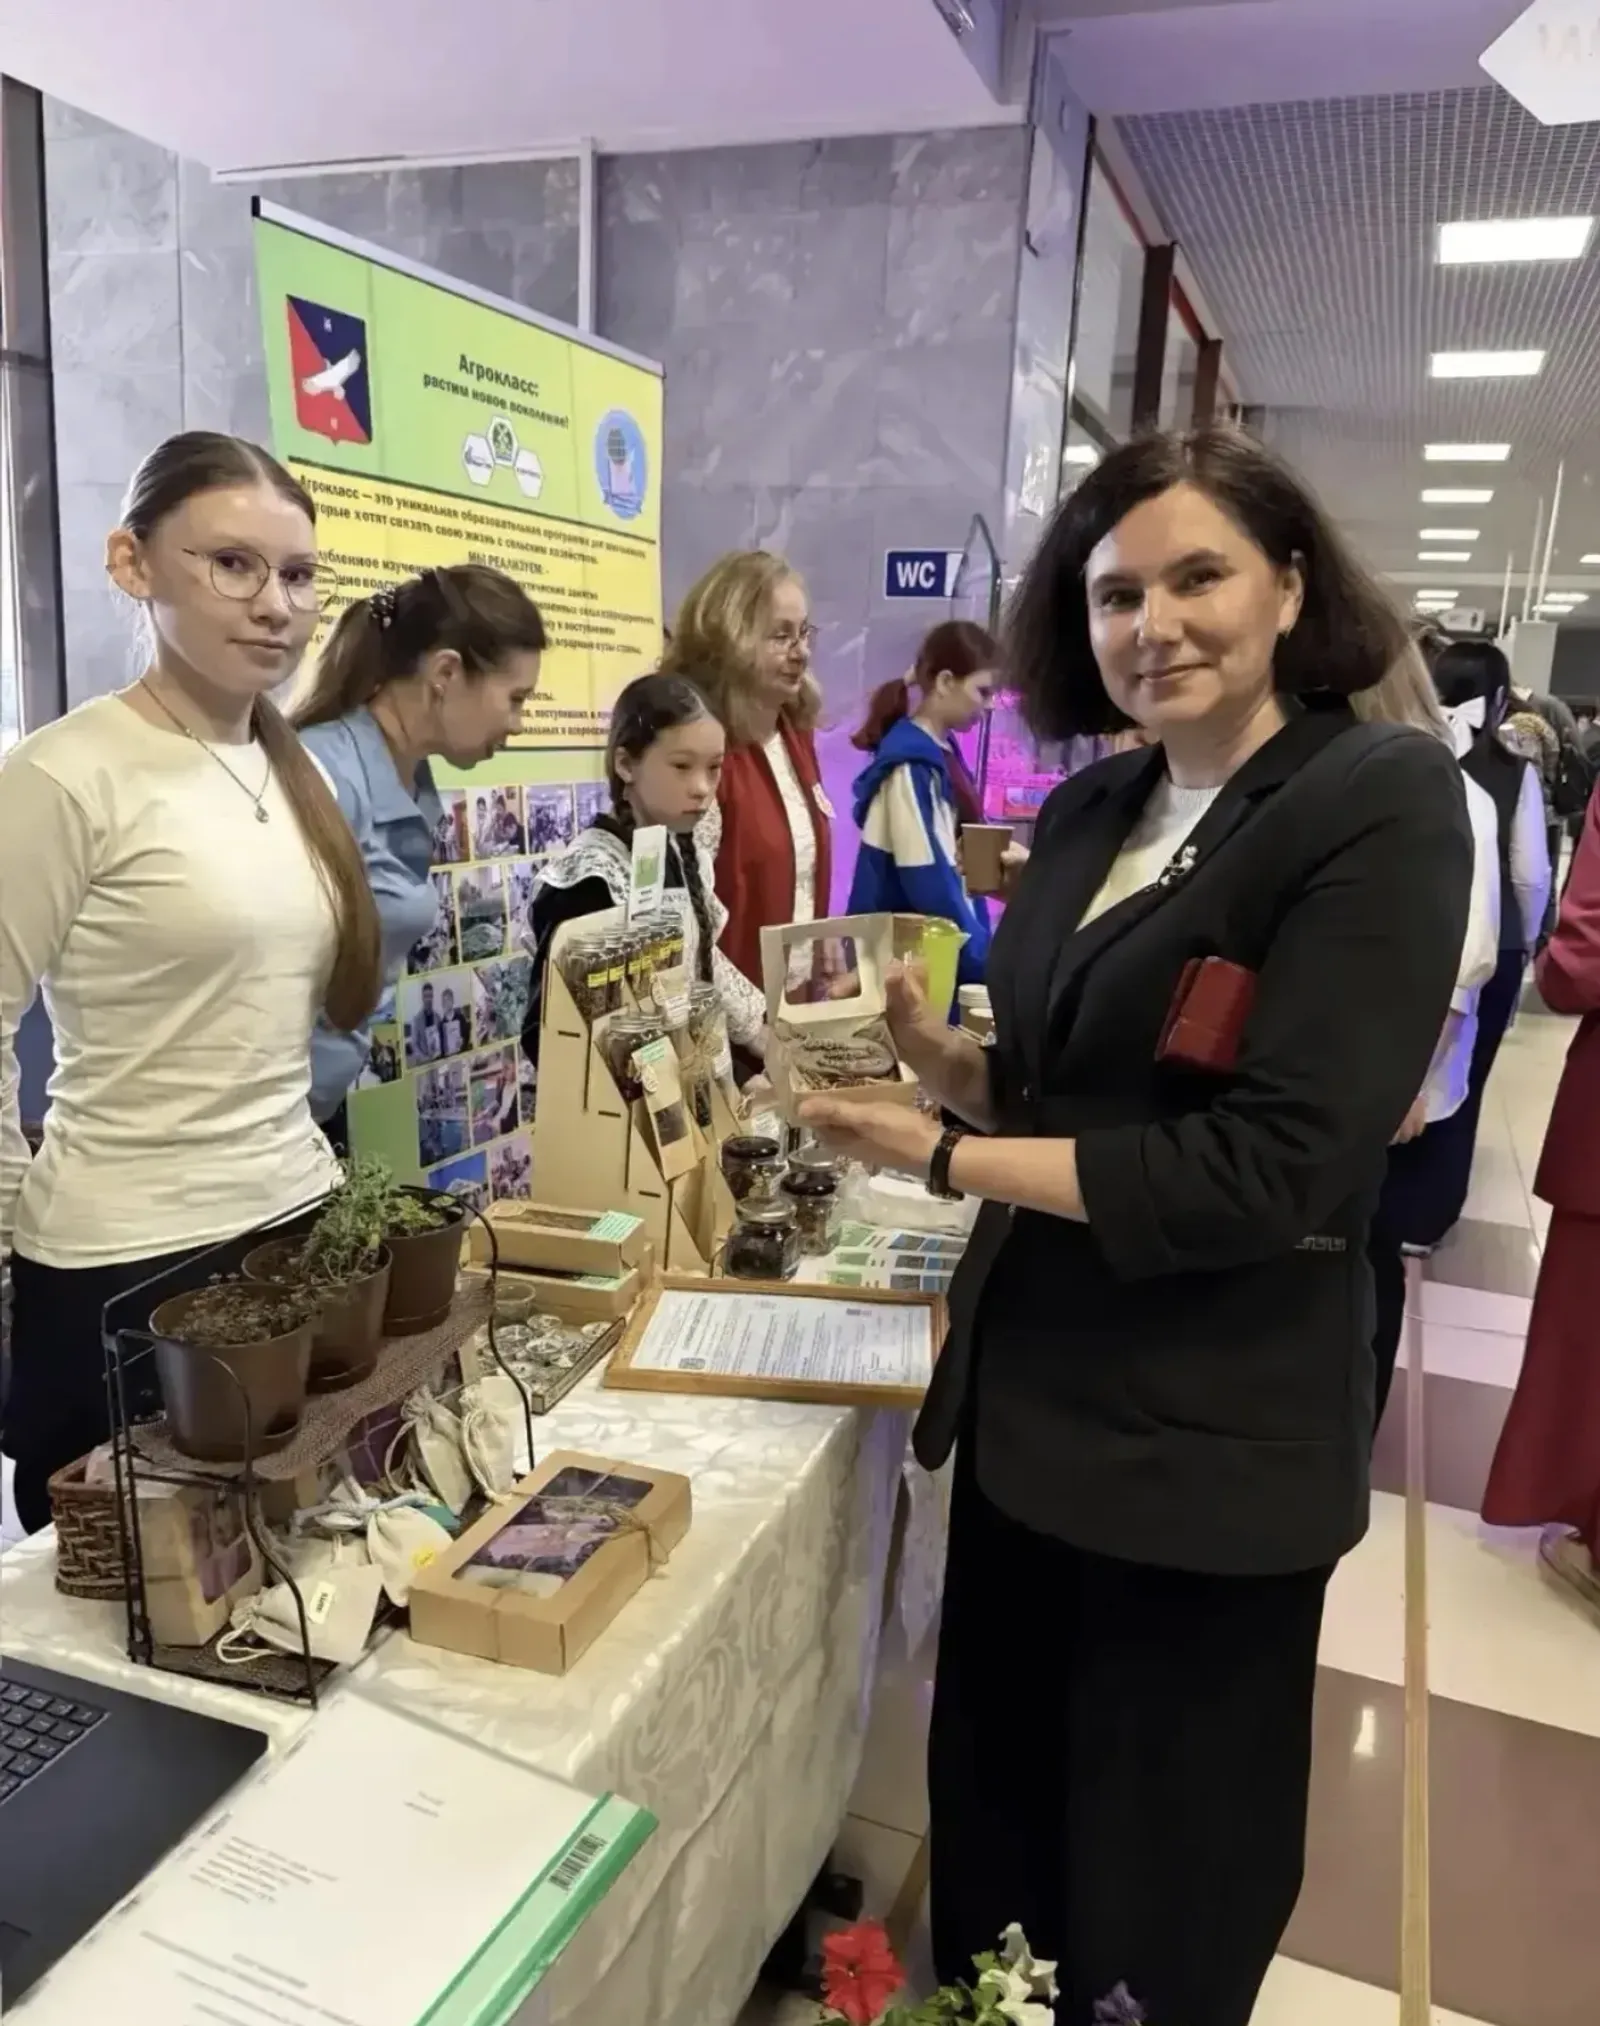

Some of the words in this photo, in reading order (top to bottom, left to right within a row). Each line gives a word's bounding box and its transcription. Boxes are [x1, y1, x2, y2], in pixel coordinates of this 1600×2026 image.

[458, 353, 540, 398] Агрокласс:
[422, 373, 470, 398] растим
[471, 387, 508, 410] новое
[509, 400, 570, 429] поколение!
[300, 474, 360, 500] Агрокласс
[374, 492, 394, 507] это
[396, 497, 459, 520] уникальная
[460, 509, 542, 537] образовательная
[354, 511, 388, 526] хотят
[389, 516, 434, 534] связать
[435, 524, 464, 541] свою
[464, 530, 496, 547] жизнь
[505, 540, 548, 556] сельским
[468, 550, 487, 567] МЫ
[896, 561, 936, 590] WC
